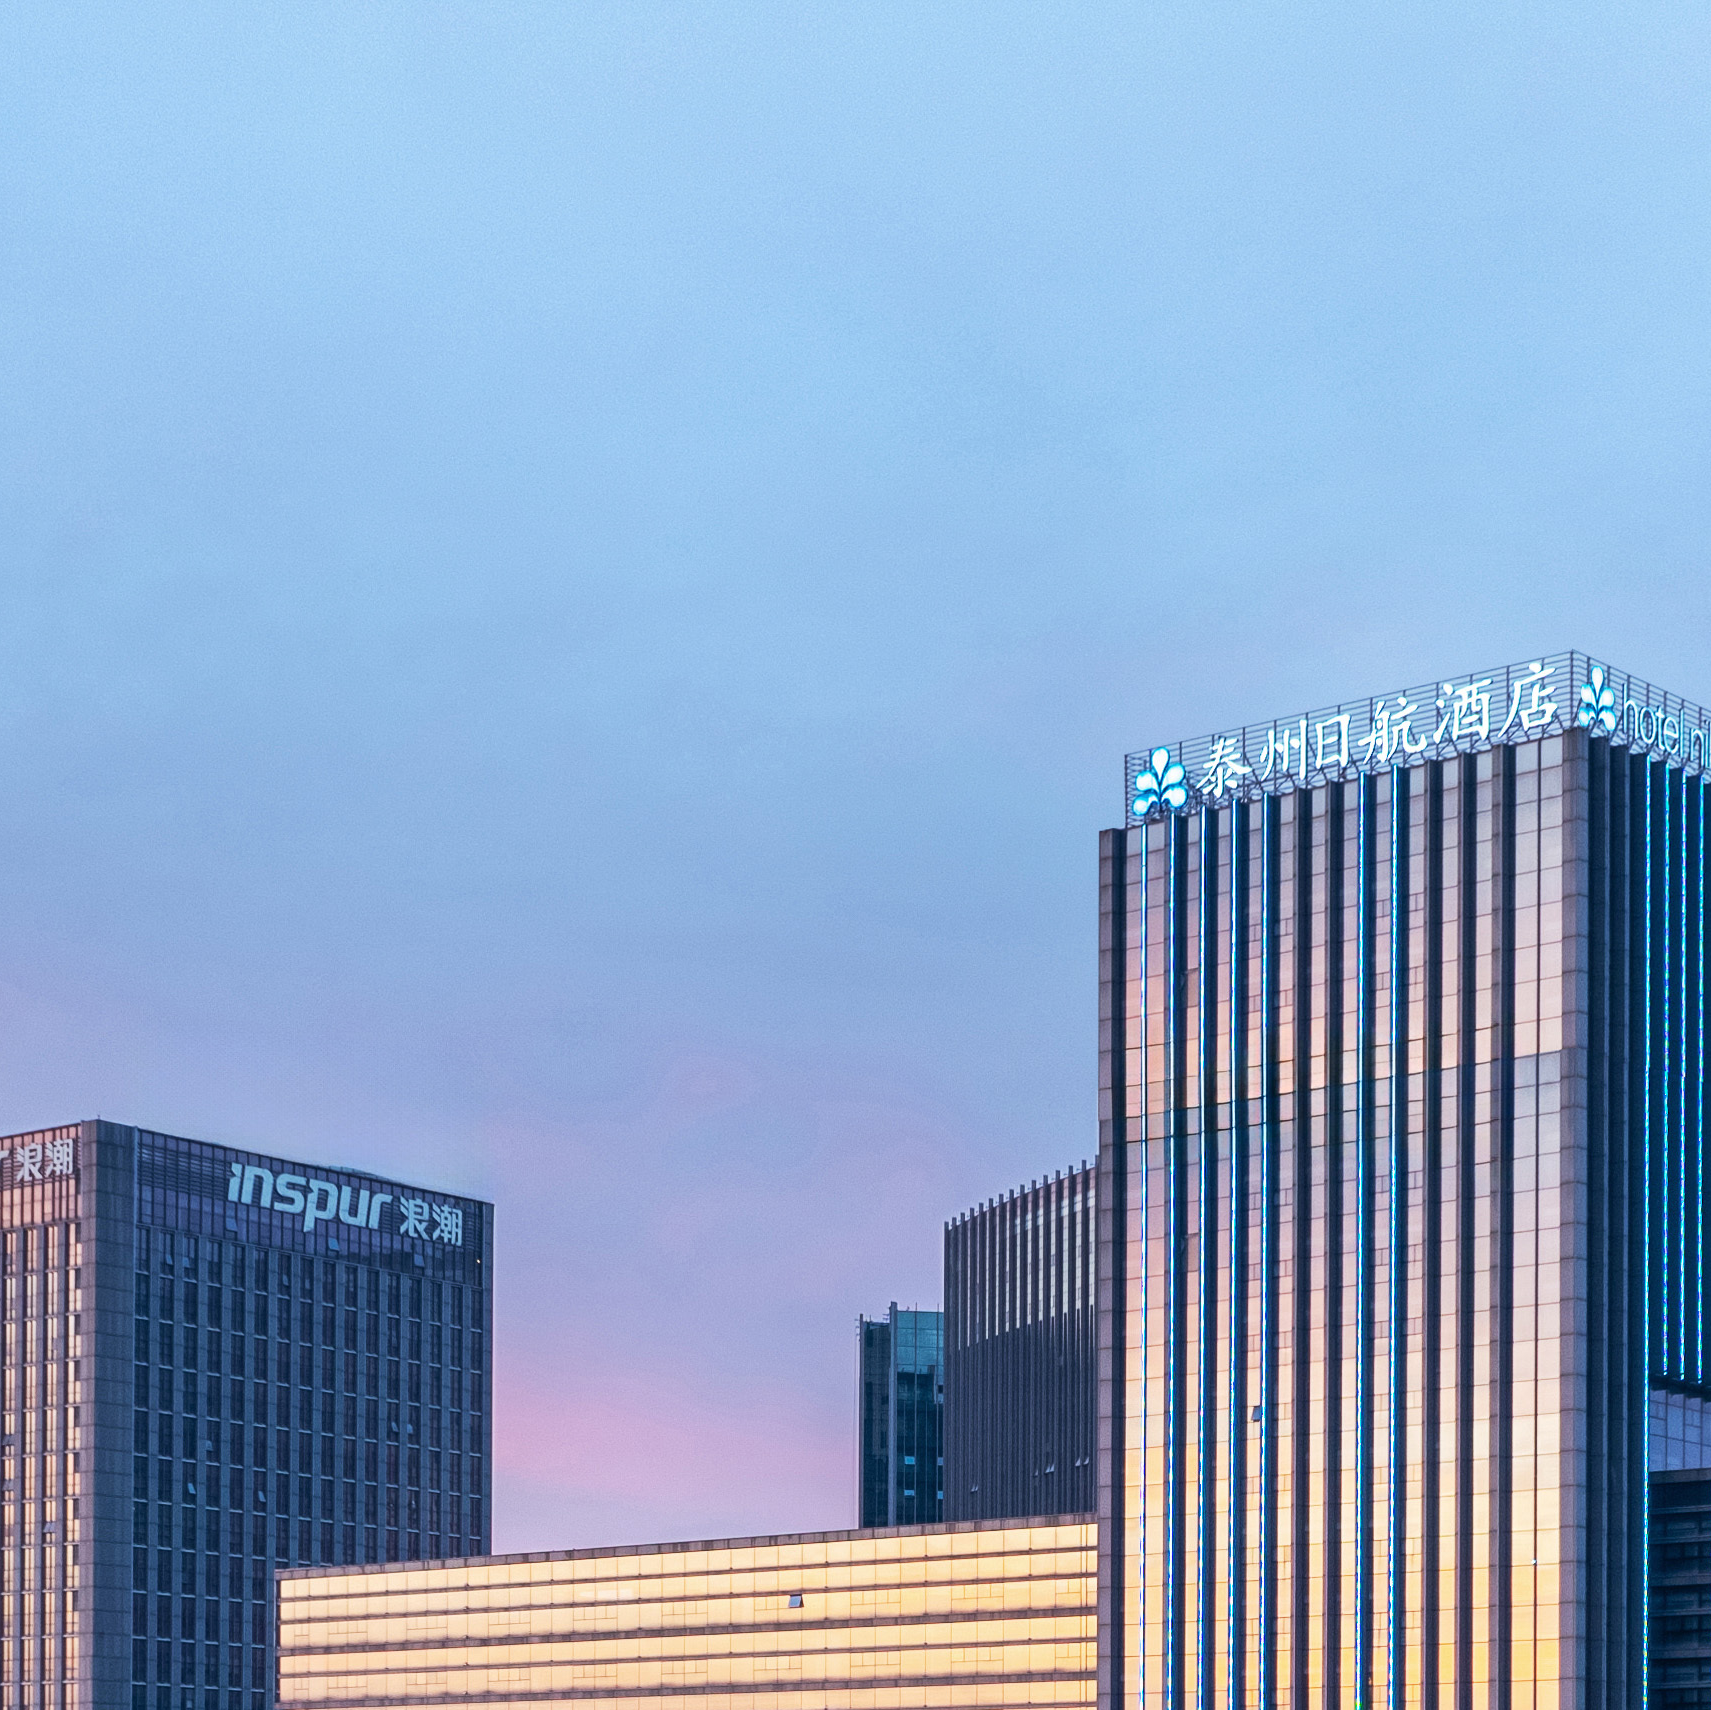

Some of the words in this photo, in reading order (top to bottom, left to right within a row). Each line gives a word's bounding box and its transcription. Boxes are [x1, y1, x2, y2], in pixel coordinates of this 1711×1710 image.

[1196, 662, 1558, 798] 泰州日航酒店
[1622, 682, 1685, 759] hotel
[16, 1138, 74, 1183] 浪潮
[228, 1162, 393, 1233] inspur
[399, 1195, 463, 1247] 浪潮
